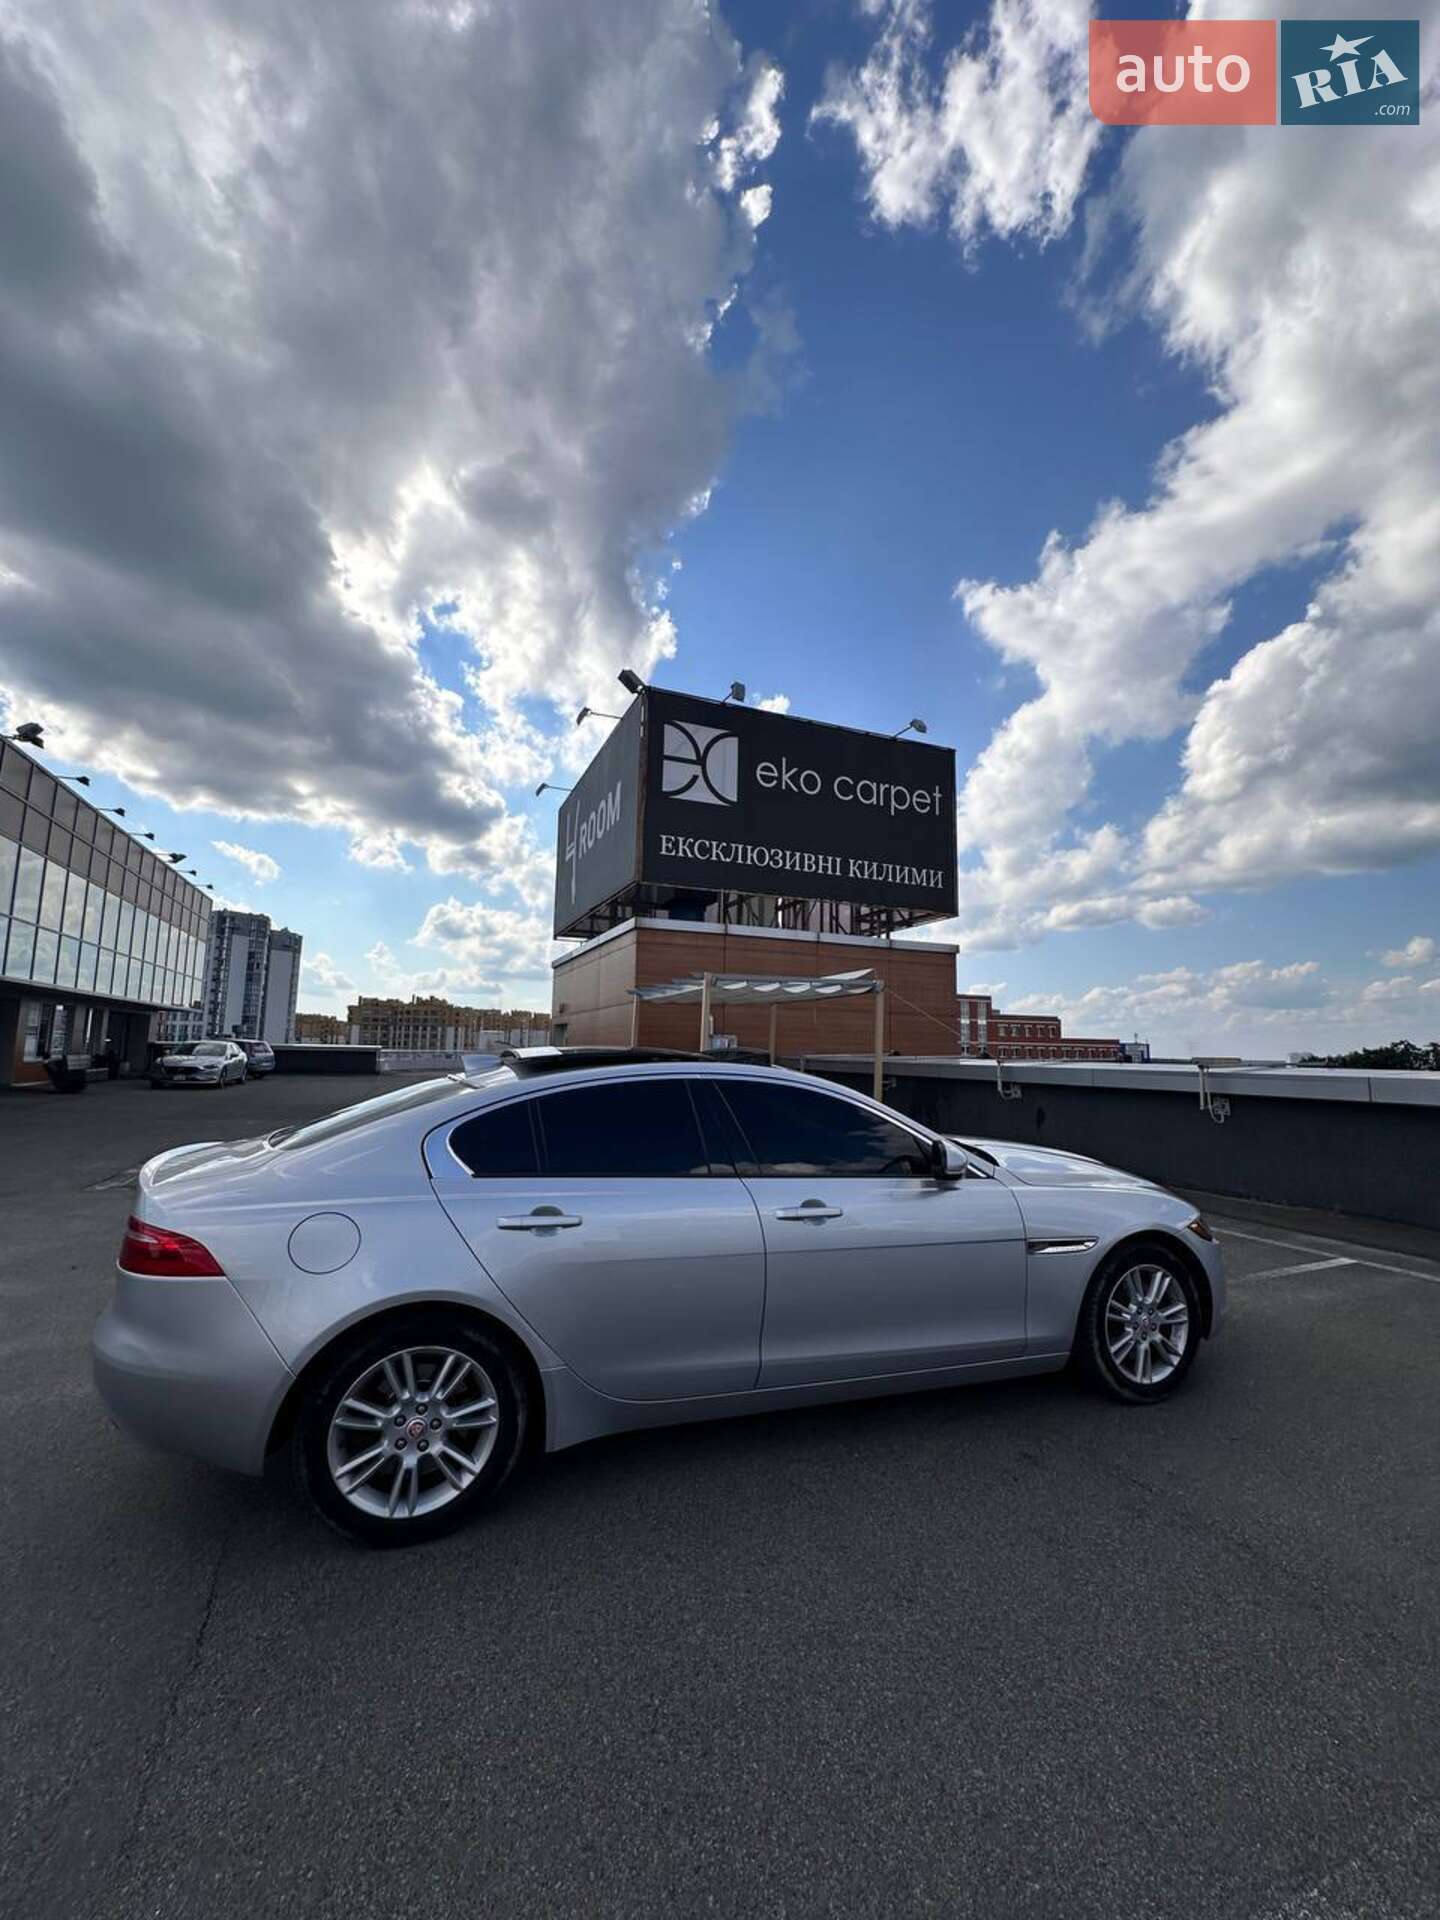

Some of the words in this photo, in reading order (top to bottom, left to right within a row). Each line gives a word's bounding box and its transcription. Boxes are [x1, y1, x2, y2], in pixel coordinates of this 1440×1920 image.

[756, 757, 821, 795] eko
[834, 776, 942, 816] carpet
[659, 834, 842, 877] ЕКСКЛЮЗИВНІ
[849, 858, 944, 889] КИЛИМИ
